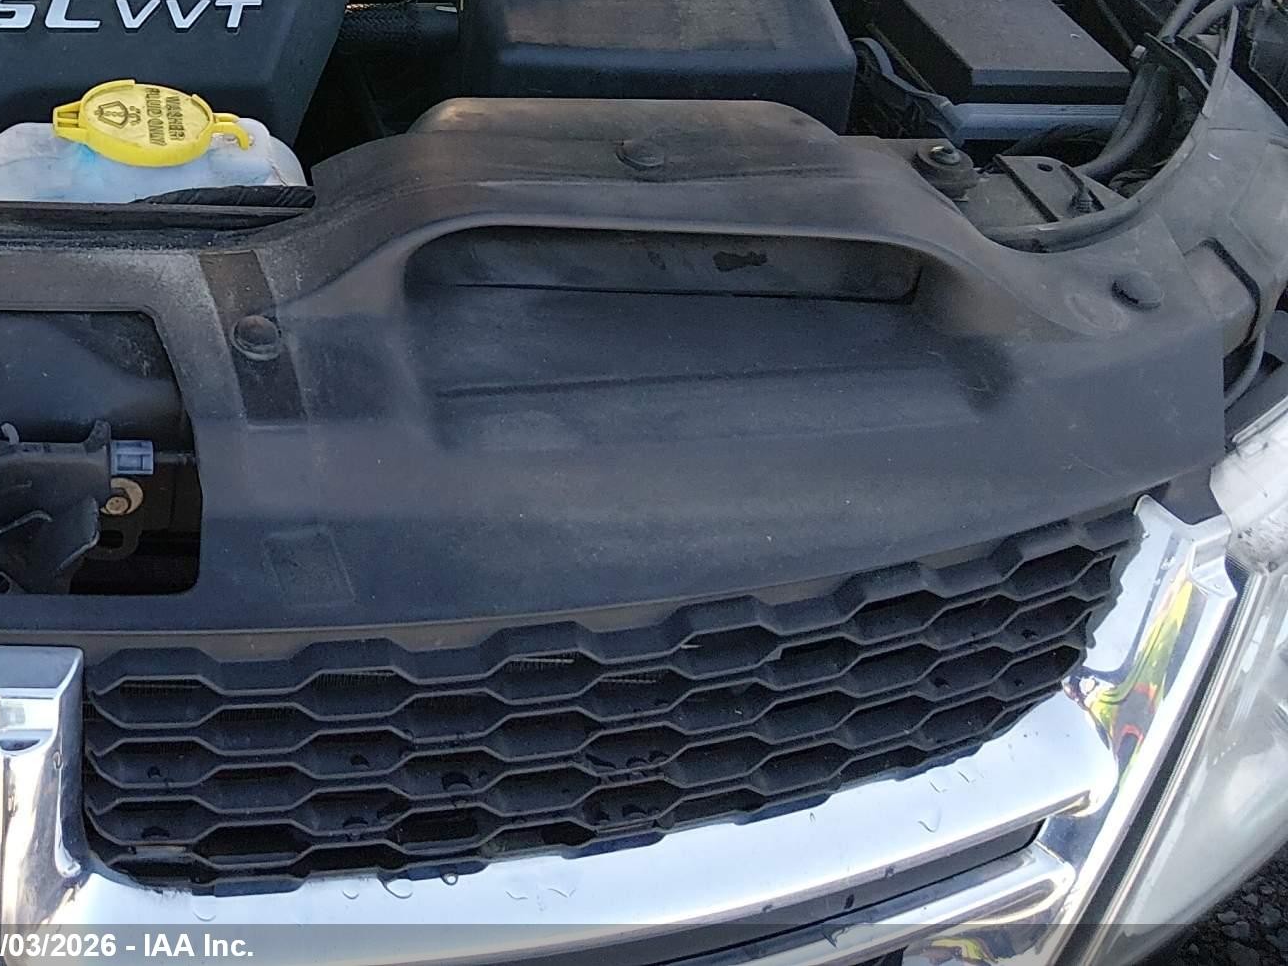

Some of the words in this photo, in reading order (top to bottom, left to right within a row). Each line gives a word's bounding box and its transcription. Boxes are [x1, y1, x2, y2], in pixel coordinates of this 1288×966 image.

[145, 88, 162, 117] FLUID
[147, 118, 167, 146] ONLY
[166, 96, 185, 141] WASHER
